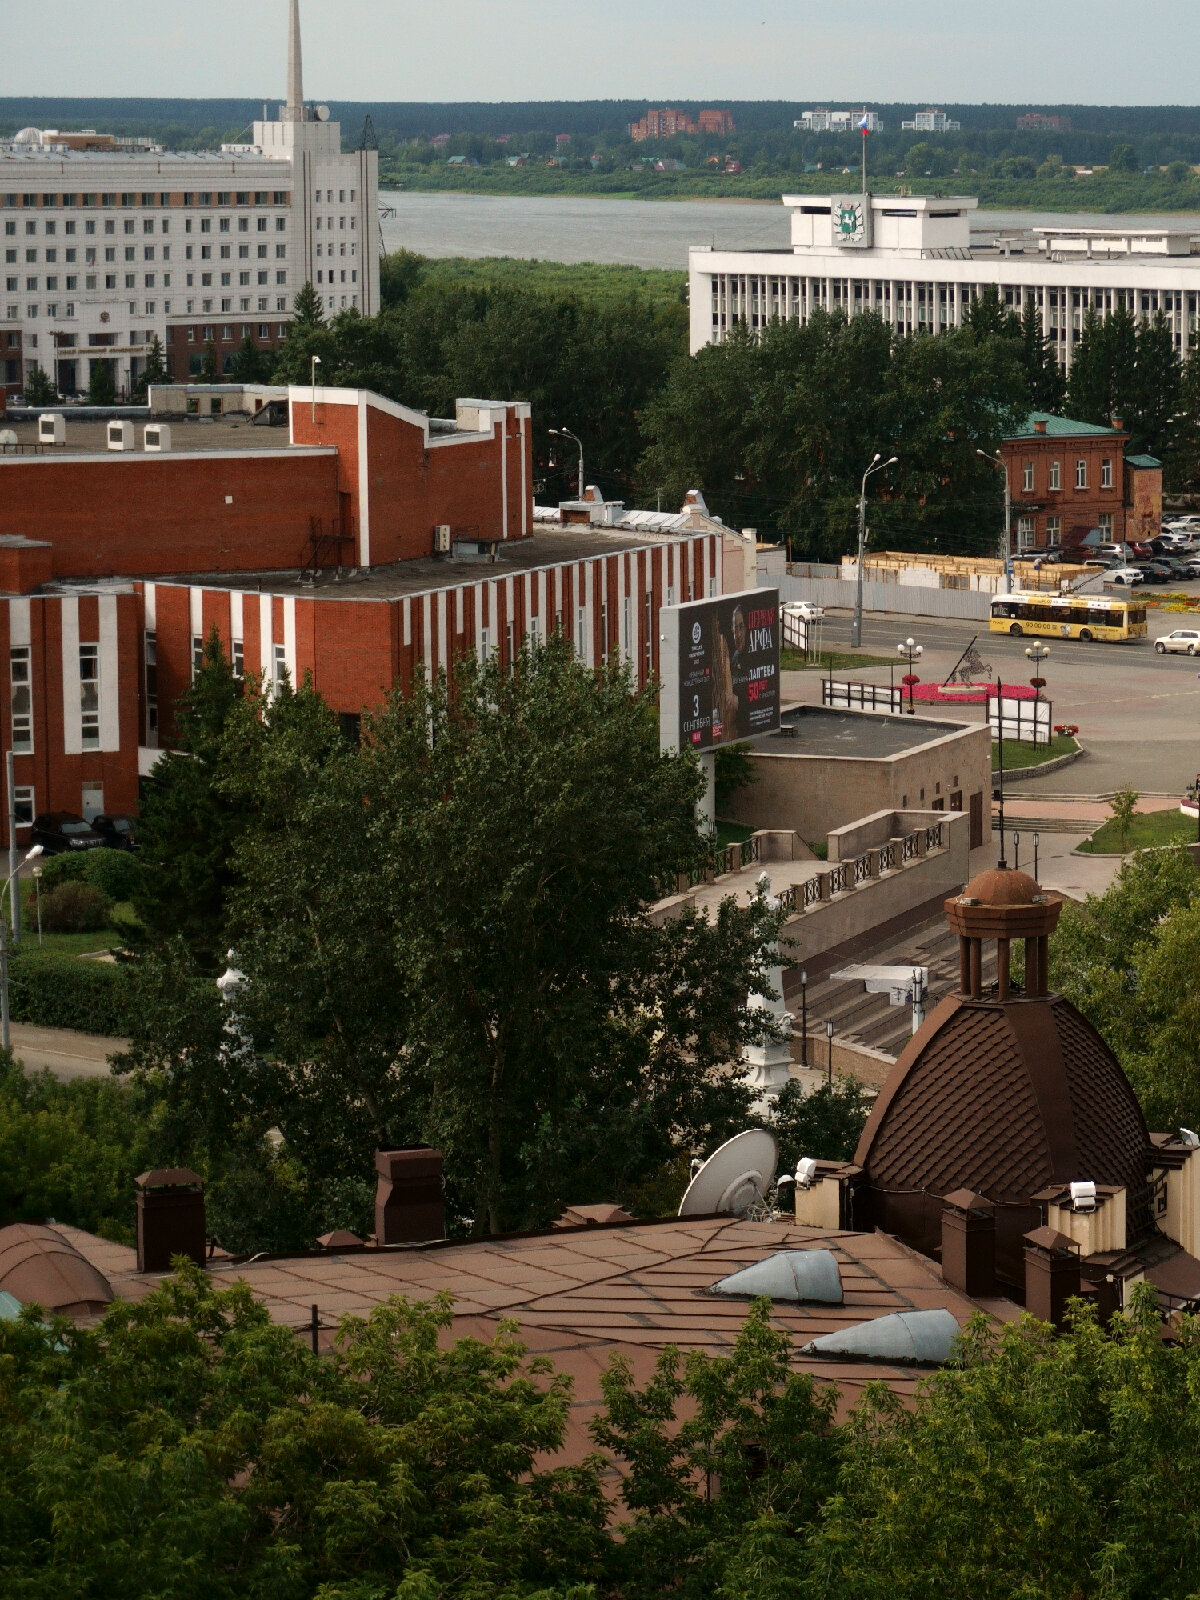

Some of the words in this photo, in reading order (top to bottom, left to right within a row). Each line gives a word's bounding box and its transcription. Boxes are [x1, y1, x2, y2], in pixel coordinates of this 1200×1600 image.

[748, 626, 773, 653] АРФА
[748, 682, 759, 702] 50
[693, 694, 699, 717] 3
[683, 716, 711, 733] СЕНТЯБРЯ
